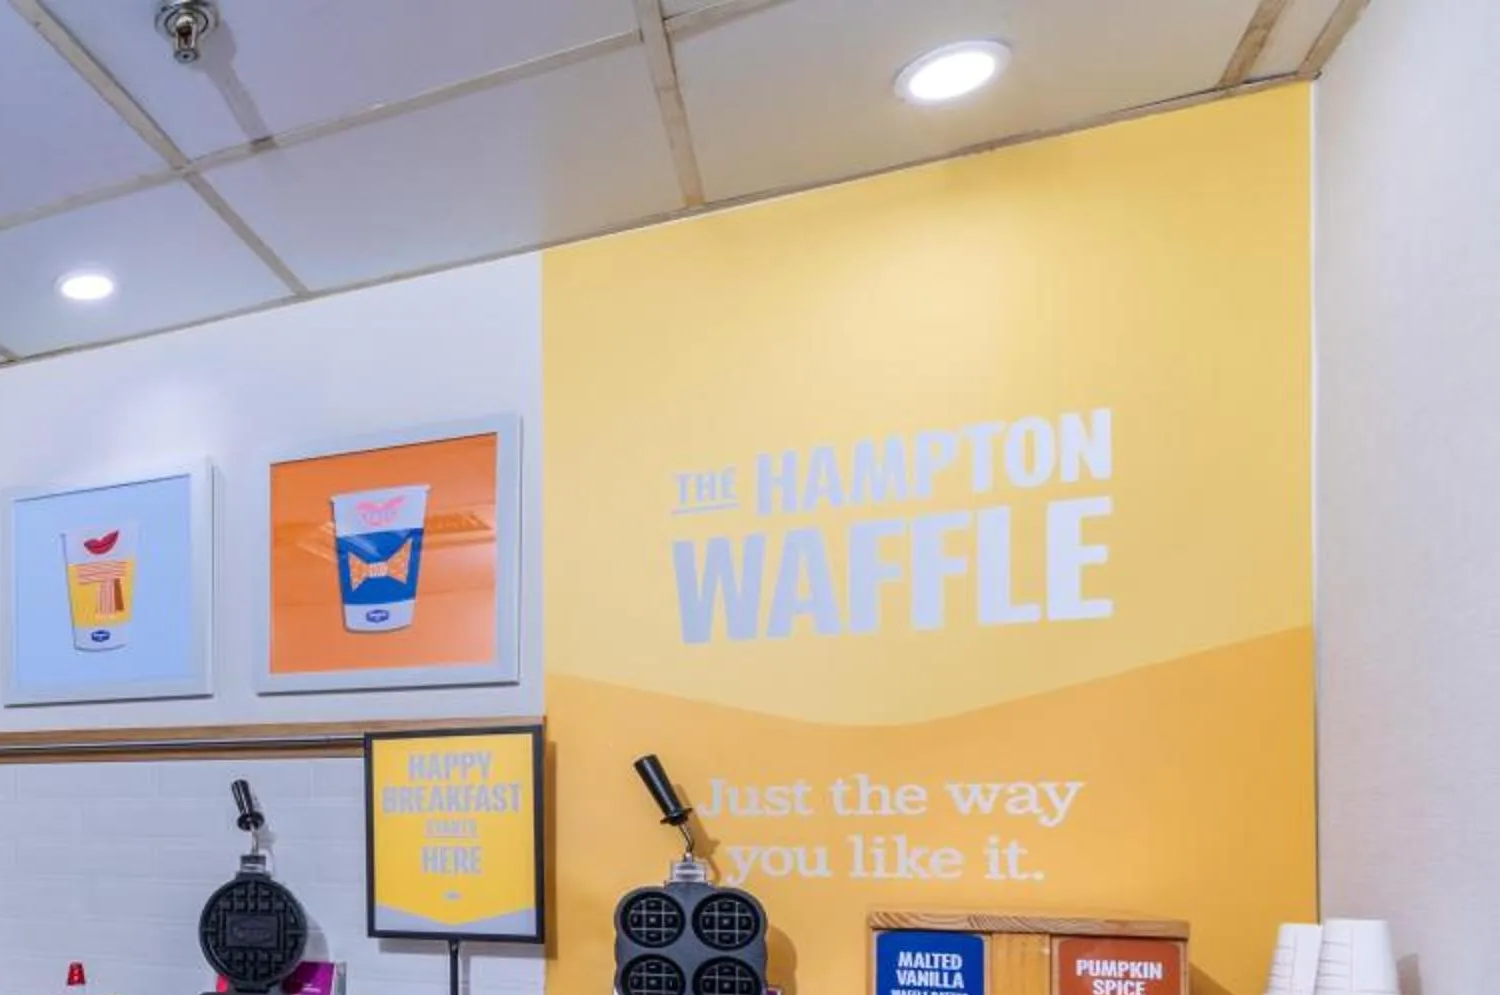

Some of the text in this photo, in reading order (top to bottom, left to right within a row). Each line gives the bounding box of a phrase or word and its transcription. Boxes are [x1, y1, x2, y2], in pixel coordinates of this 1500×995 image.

[672, 407, 1114, 517] THE HAMPTON
[671, 495, 1114, 645] WAFFLE
[408, 751, 492, 781] HAPPY
[381, 783, 522, 814] BREAKFAST
[697, 773, 1086, 828] Just the way
[420, 846, 483, 875] HERE
[725, 834, 1045, 886] you like it.
[898, 951, 963, 971] MALTED
[1075, 959, 1163, 979] PUMPKIN
[895, 969, 965, 989] VANILLA
